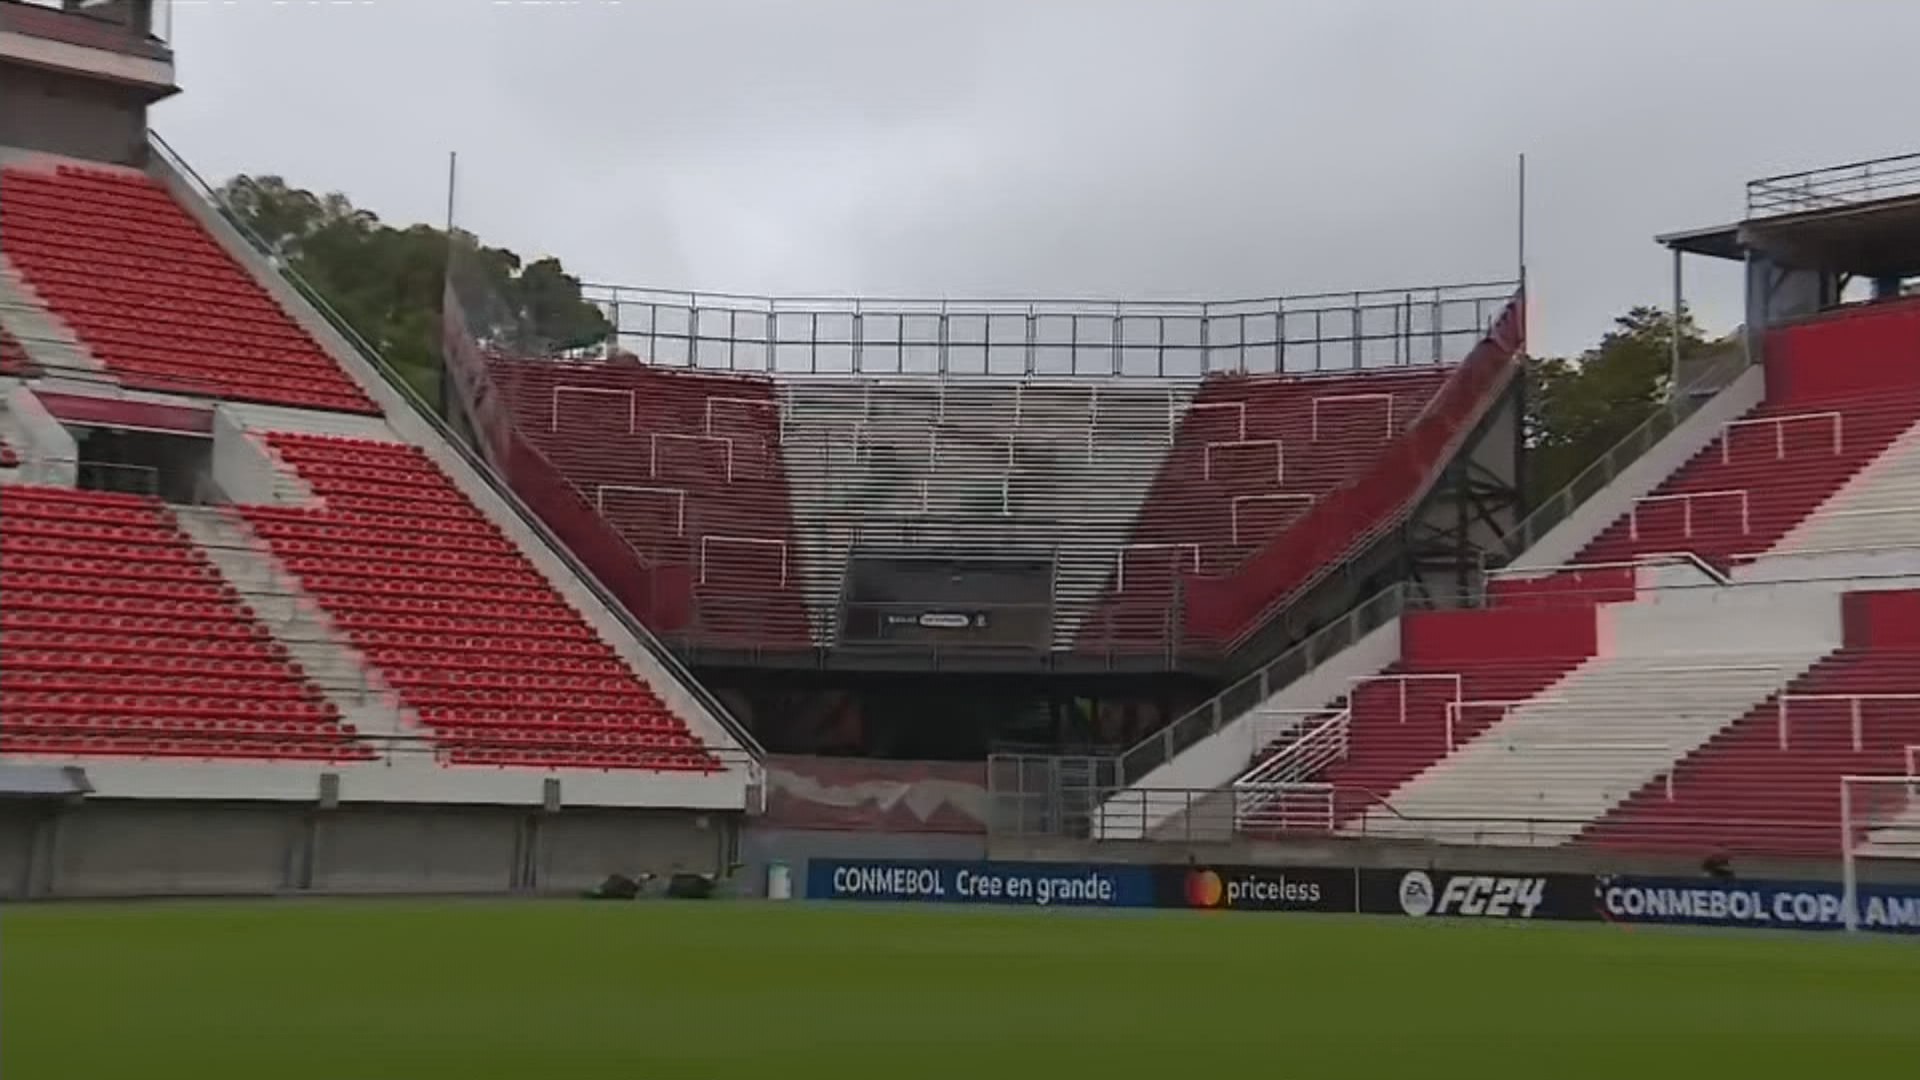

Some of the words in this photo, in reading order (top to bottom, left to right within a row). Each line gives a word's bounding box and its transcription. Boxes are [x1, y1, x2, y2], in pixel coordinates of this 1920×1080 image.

[833, 867, 945, 895] CONMEBOL
[956, 870, 1001, 896] Cree
[1006, 876, 1032, 897] en
[1036, 874, 1111, 904] grande
[1227, 874, 1320, 904] priceless
[1406, 881, 1426, 895] EA
[1606, 887, 1769, 920] CONMEBOL
